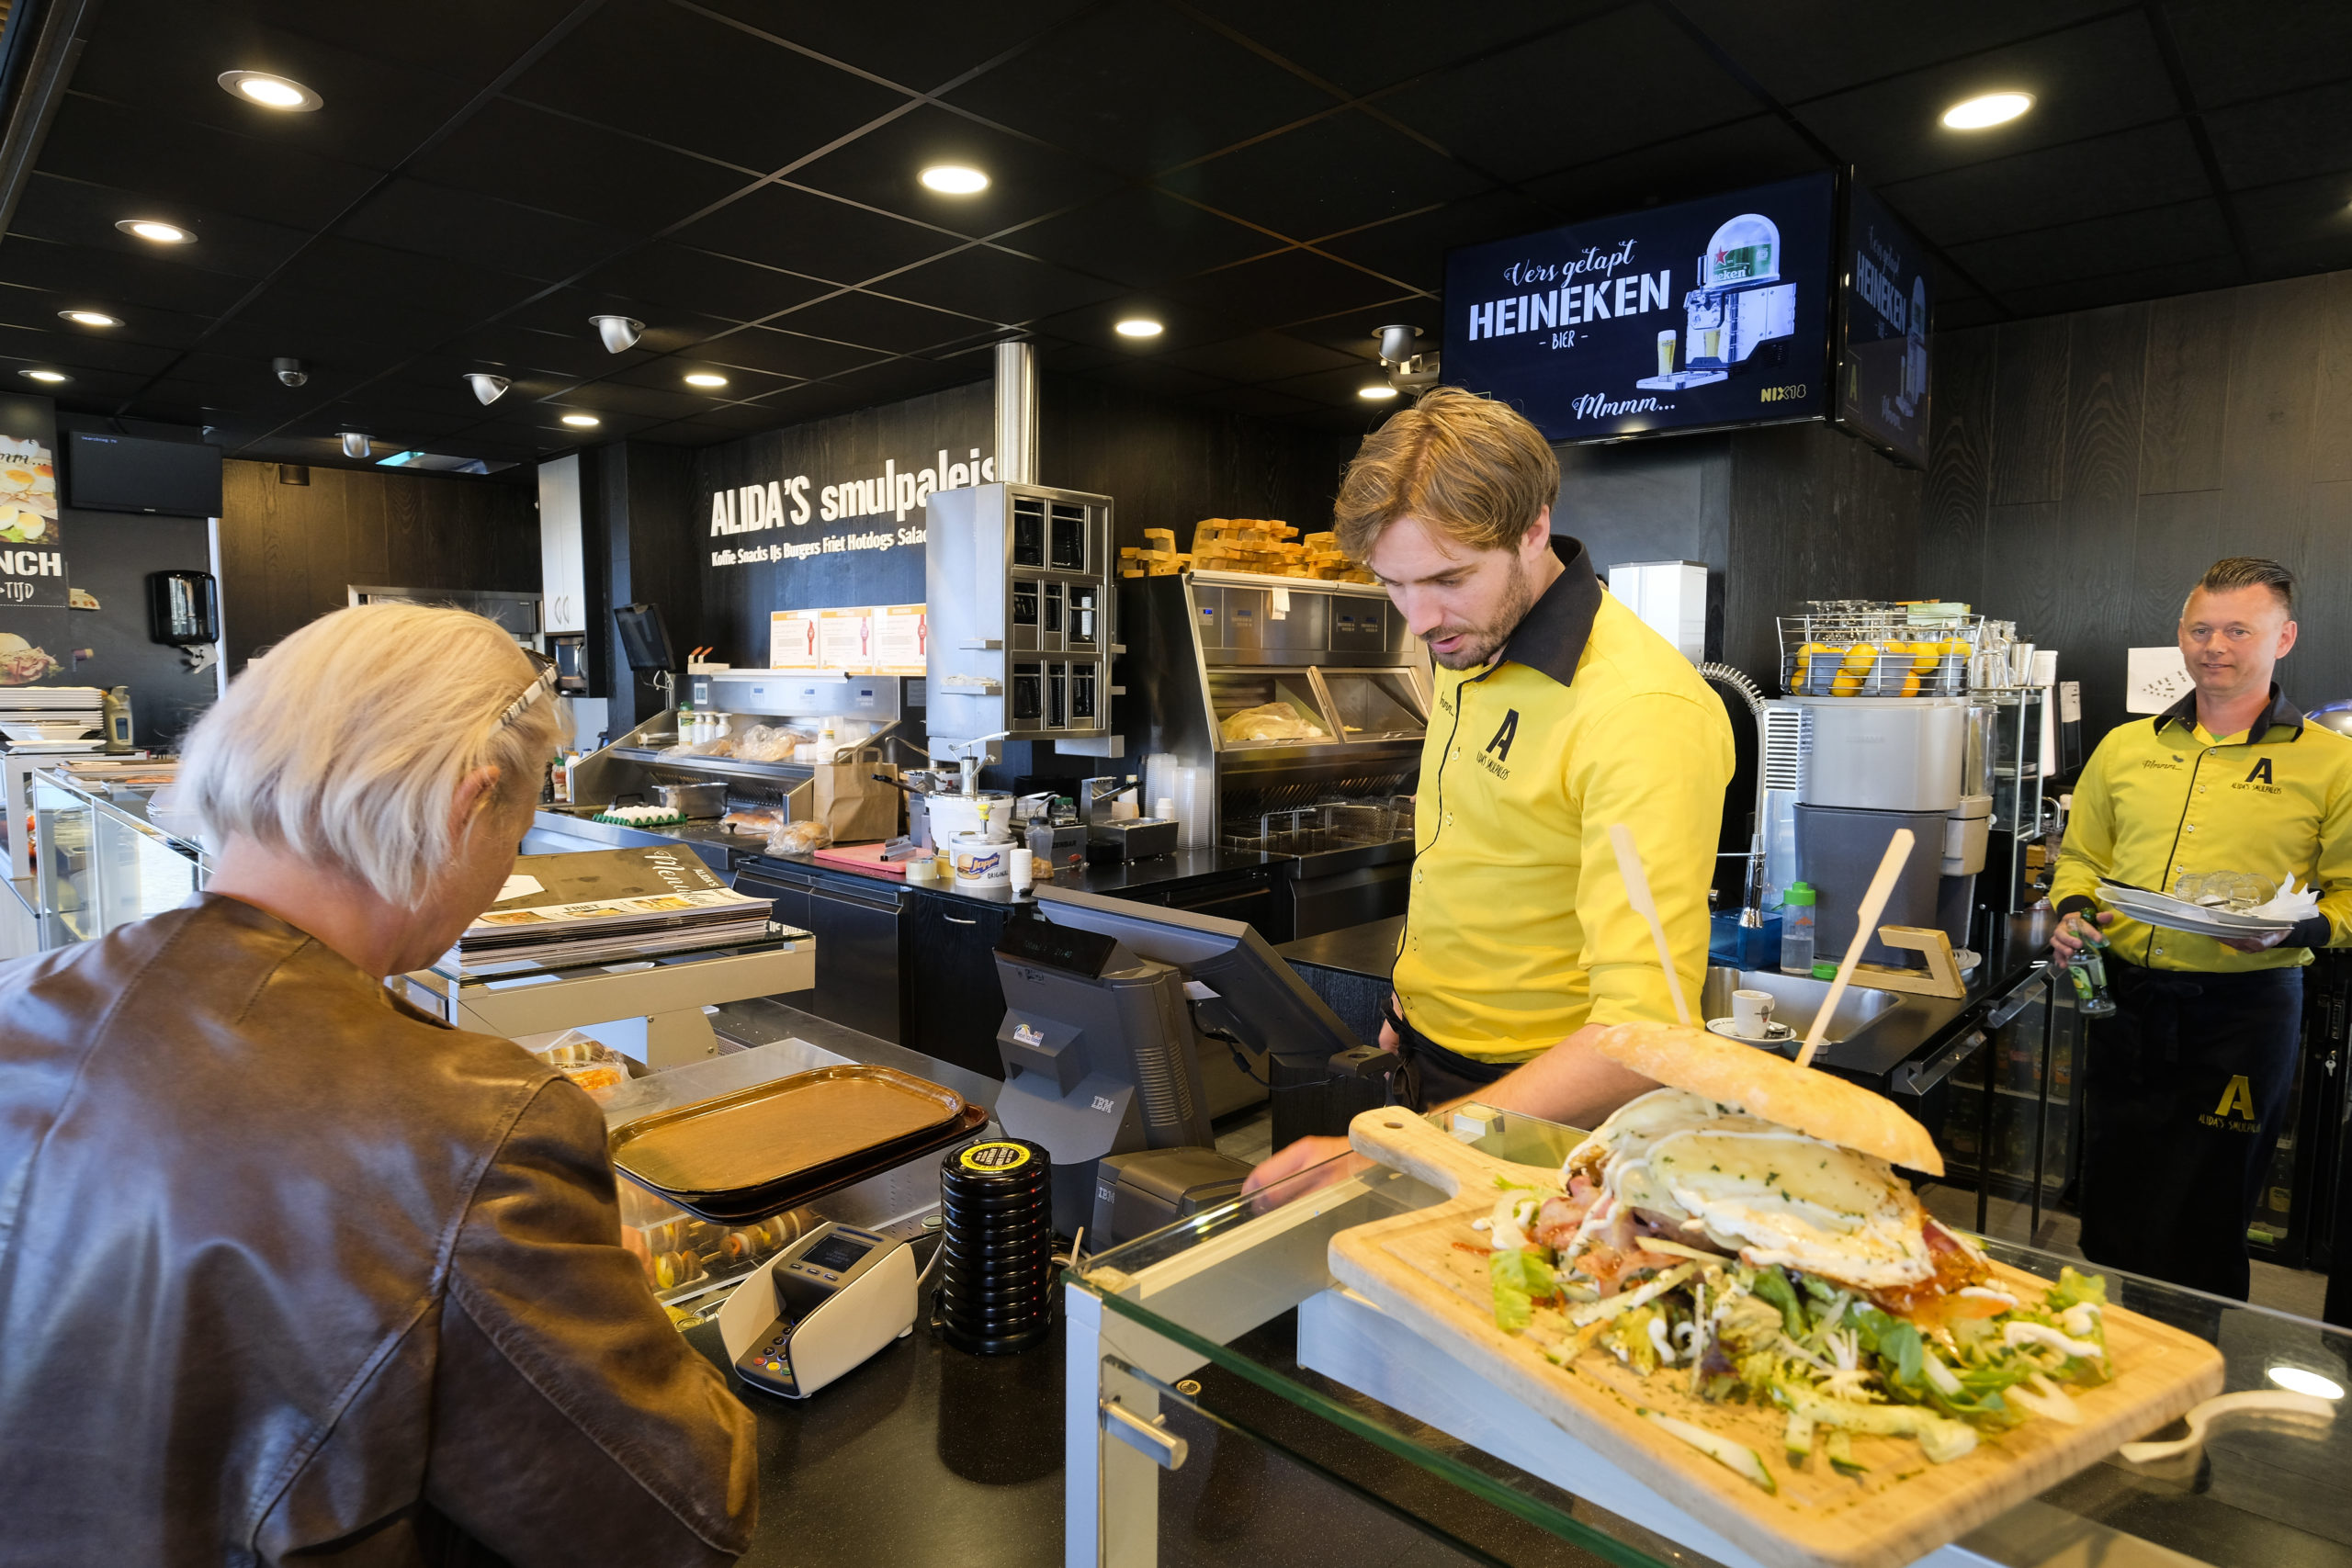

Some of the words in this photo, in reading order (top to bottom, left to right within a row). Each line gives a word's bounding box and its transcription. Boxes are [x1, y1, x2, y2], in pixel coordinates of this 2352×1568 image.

[1504, 258, 1559, 287] Vers
[1560, 238, 1638, 288] getapt
[1468, 269, 1671, 342] HEINEKEN
[1856, 250, 1906, 335] HEINEKEN
[1552, 331, 1575, 350] BIER
[1760, 384, 1806, 402] NIX18
[710, 475, 811, 536] ALIDA'S
[711, 551, 736, 567] Koffie
[737, 546, 769, 564] Snacks
[783, 541, 821, 560] Burgers
[822, 535, 846, 554] Friet
[847, 531, 895, 551] Hotdogs
[2245, 756, 2273, 784] A
[1091, 1095, 1114, 1113] IBM
[2214, 1074, 2256, 1121] A
